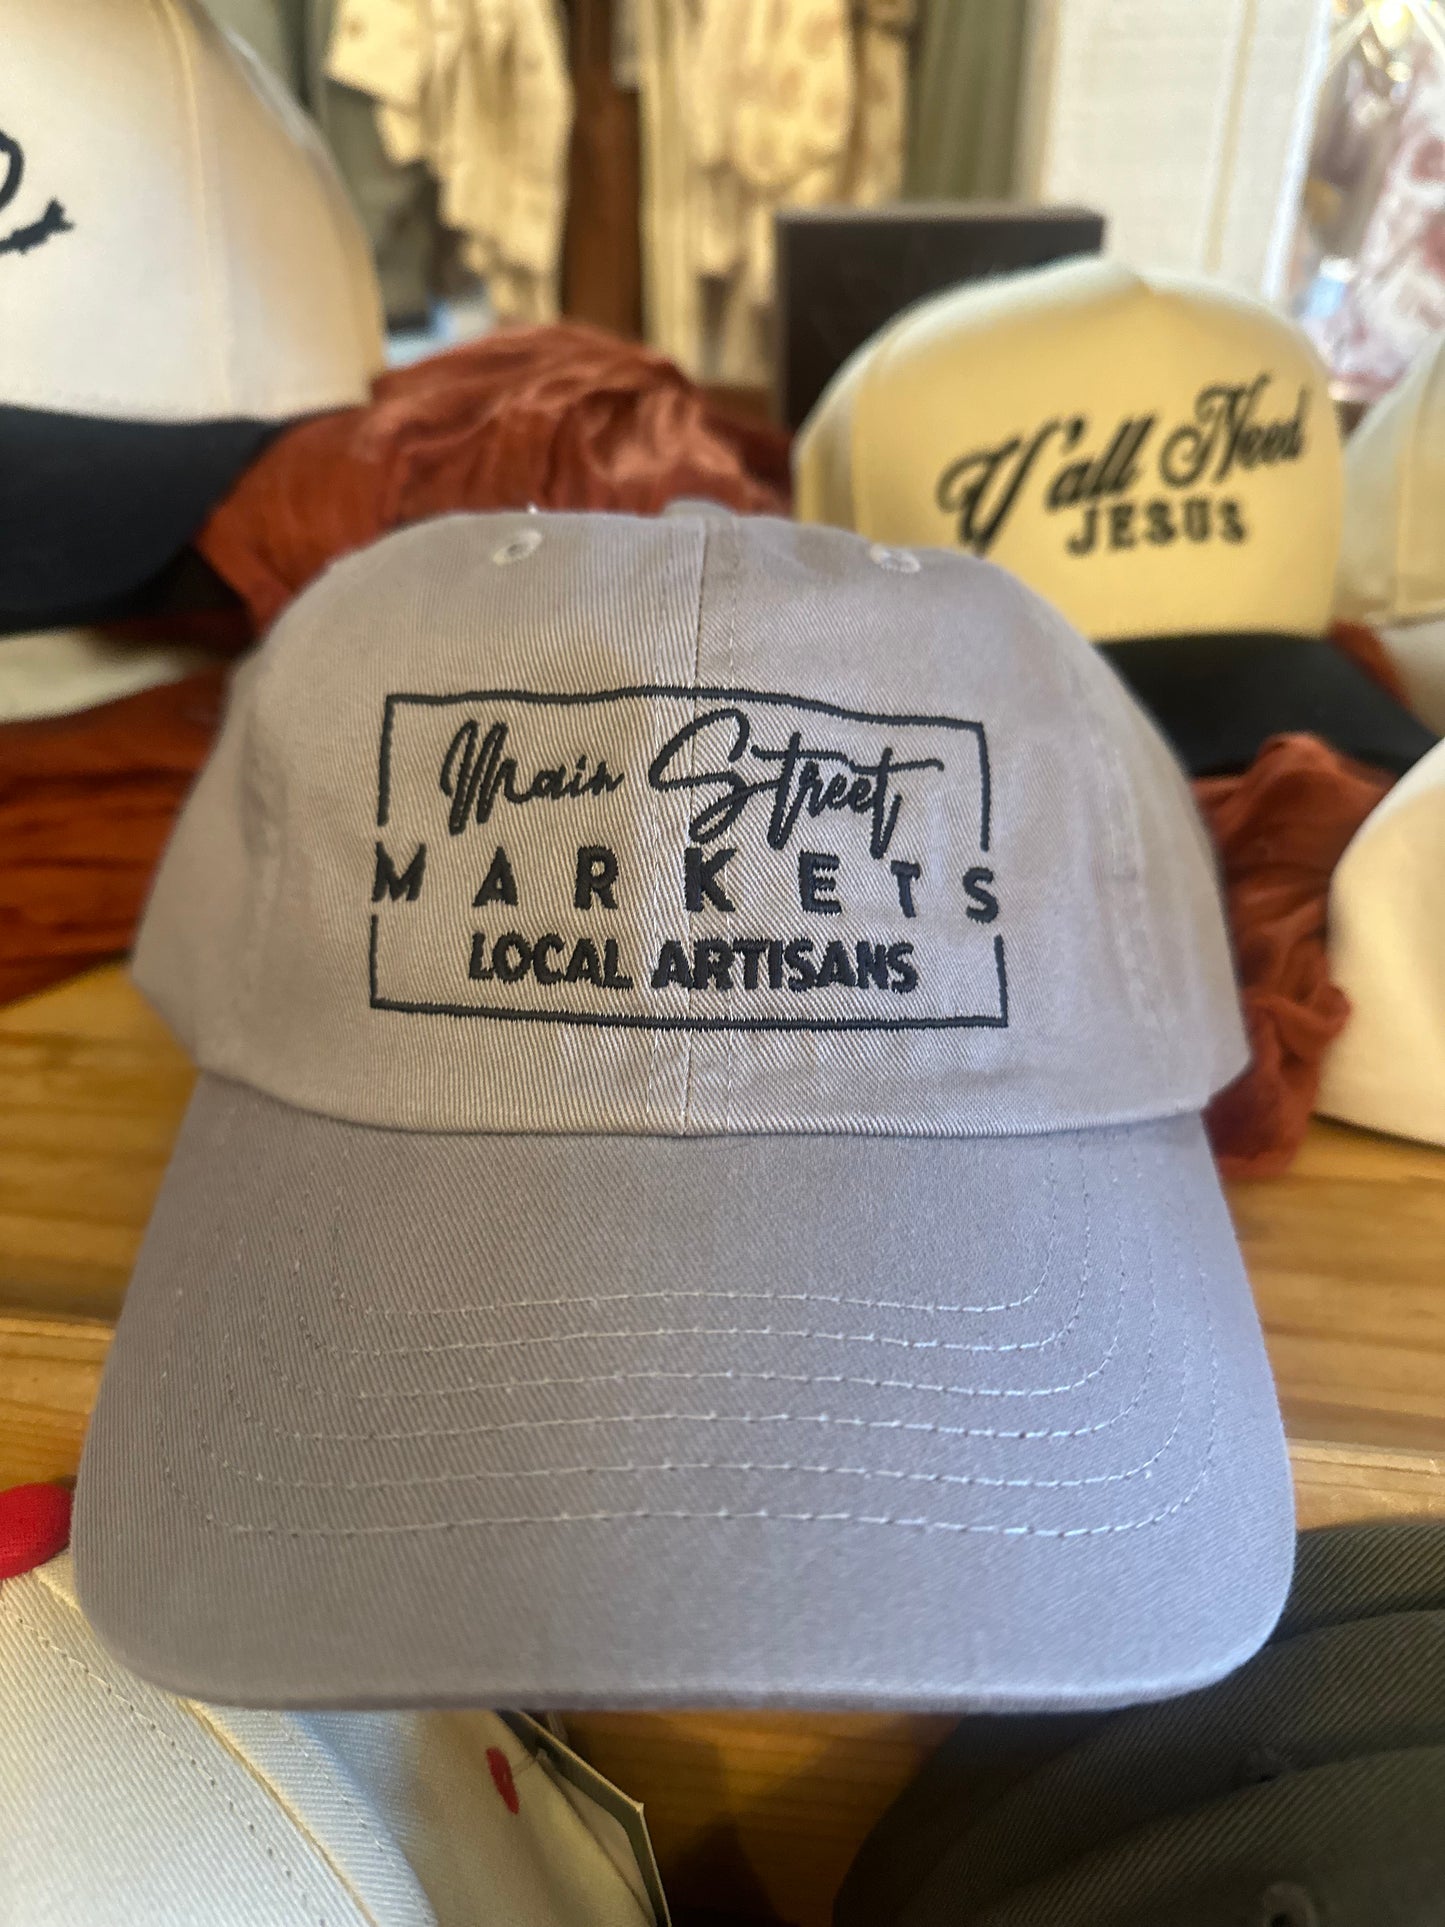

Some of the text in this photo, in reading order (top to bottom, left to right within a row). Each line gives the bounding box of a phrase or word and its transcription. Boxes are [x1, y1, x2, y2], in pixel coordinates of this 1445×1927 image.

[1159, 370, 1310, 488] Need
[1065, 495, 1248, 556] JESUS
[440, 707, 945, 859] Main Street
[371, 840, 1001, 923] MARKETS
[468, 931, 920, 994] LOCAL ARTISANS
